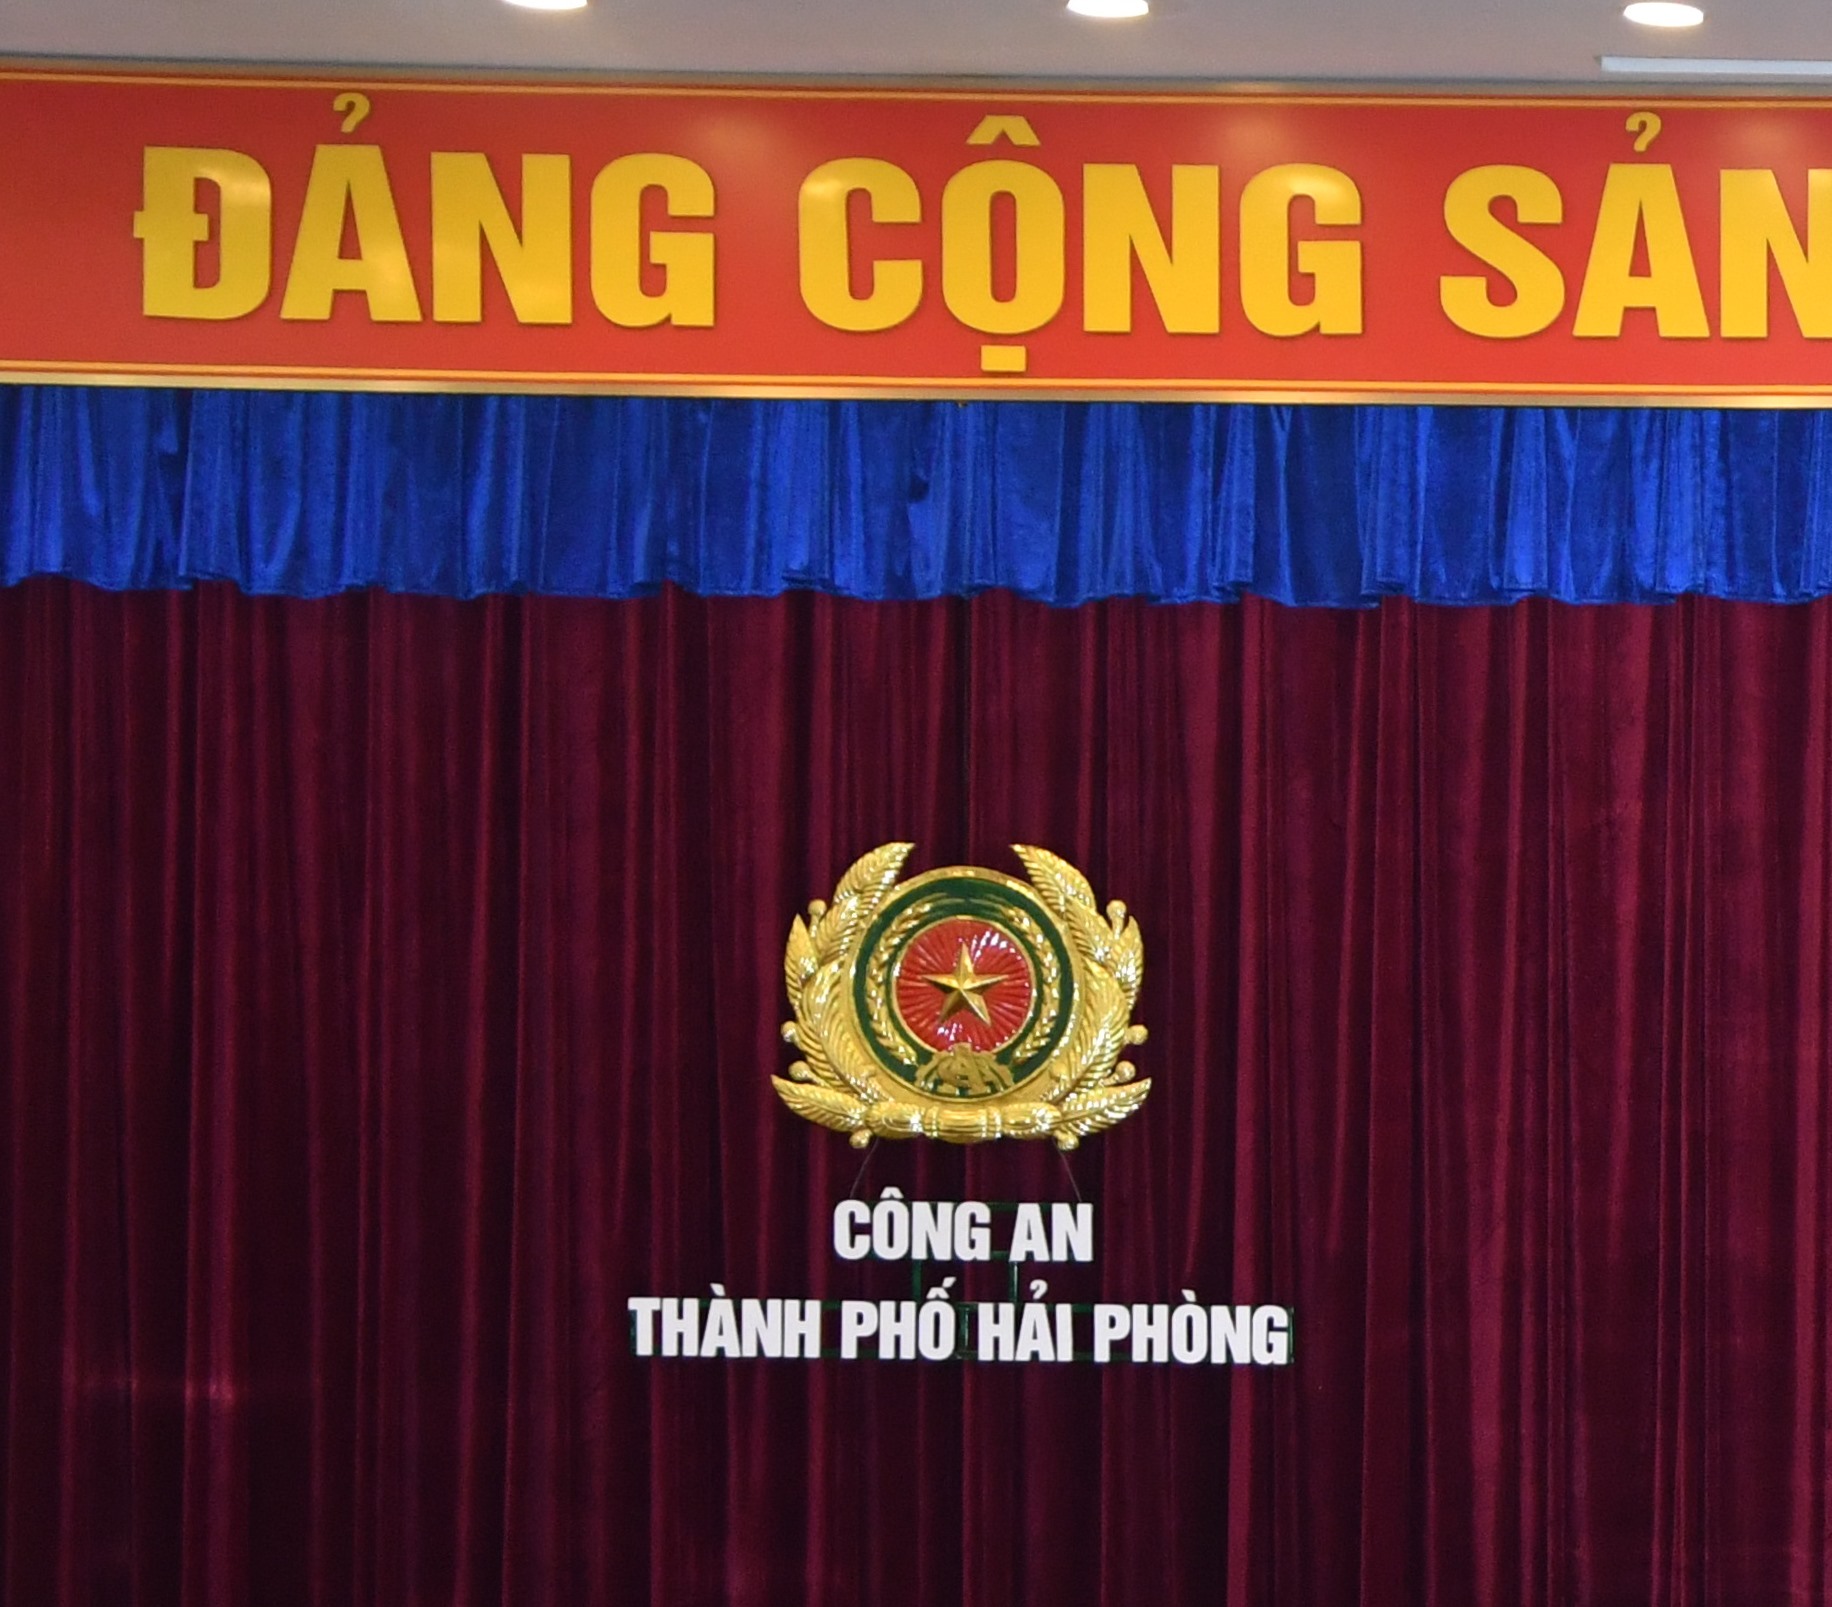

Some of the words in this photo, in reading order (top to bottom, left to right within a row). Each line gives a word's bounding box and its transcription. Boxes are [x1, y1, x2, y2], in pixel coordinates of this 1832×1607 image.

[134, 89, 716, 327] ĐẢNG
[799, 117, 1362, 371] CỘNG
[833, 1187, 992, 1262] CÔNG
[1009, 1202, 1094, 1263] AN
[627, 1284, 822, 1360] THÀNH
[840, 1277, 958, 1362] PHỐ
[977, 1279, 1075, 1364] HẢI
[1093, 1289, 1291, 1366] PHÒNG
